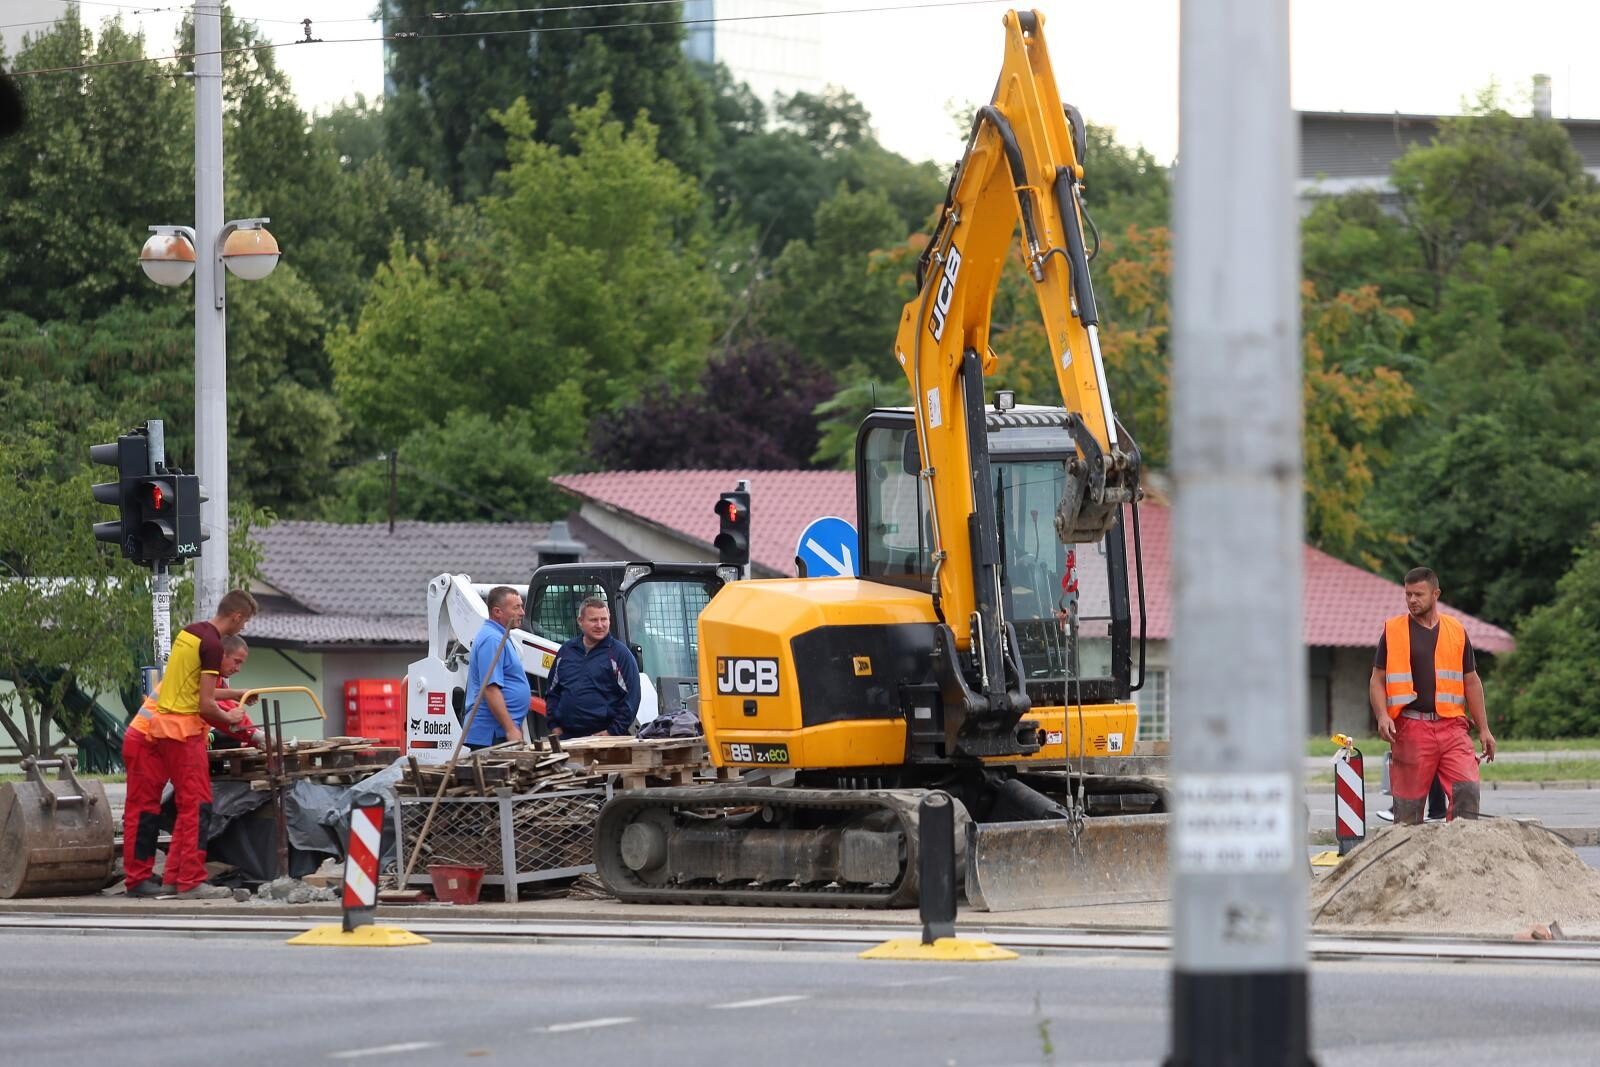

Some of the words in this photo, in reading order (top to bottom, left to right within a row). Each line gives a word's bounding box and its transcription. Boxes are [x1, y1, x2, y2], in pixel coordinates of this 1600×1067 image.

[934, 246, 961, 341] JCB
[718, 660, 778, 693] JCB
[424, 721, 451, 734] Bobcat
[730, 744, 752, 762] 85
